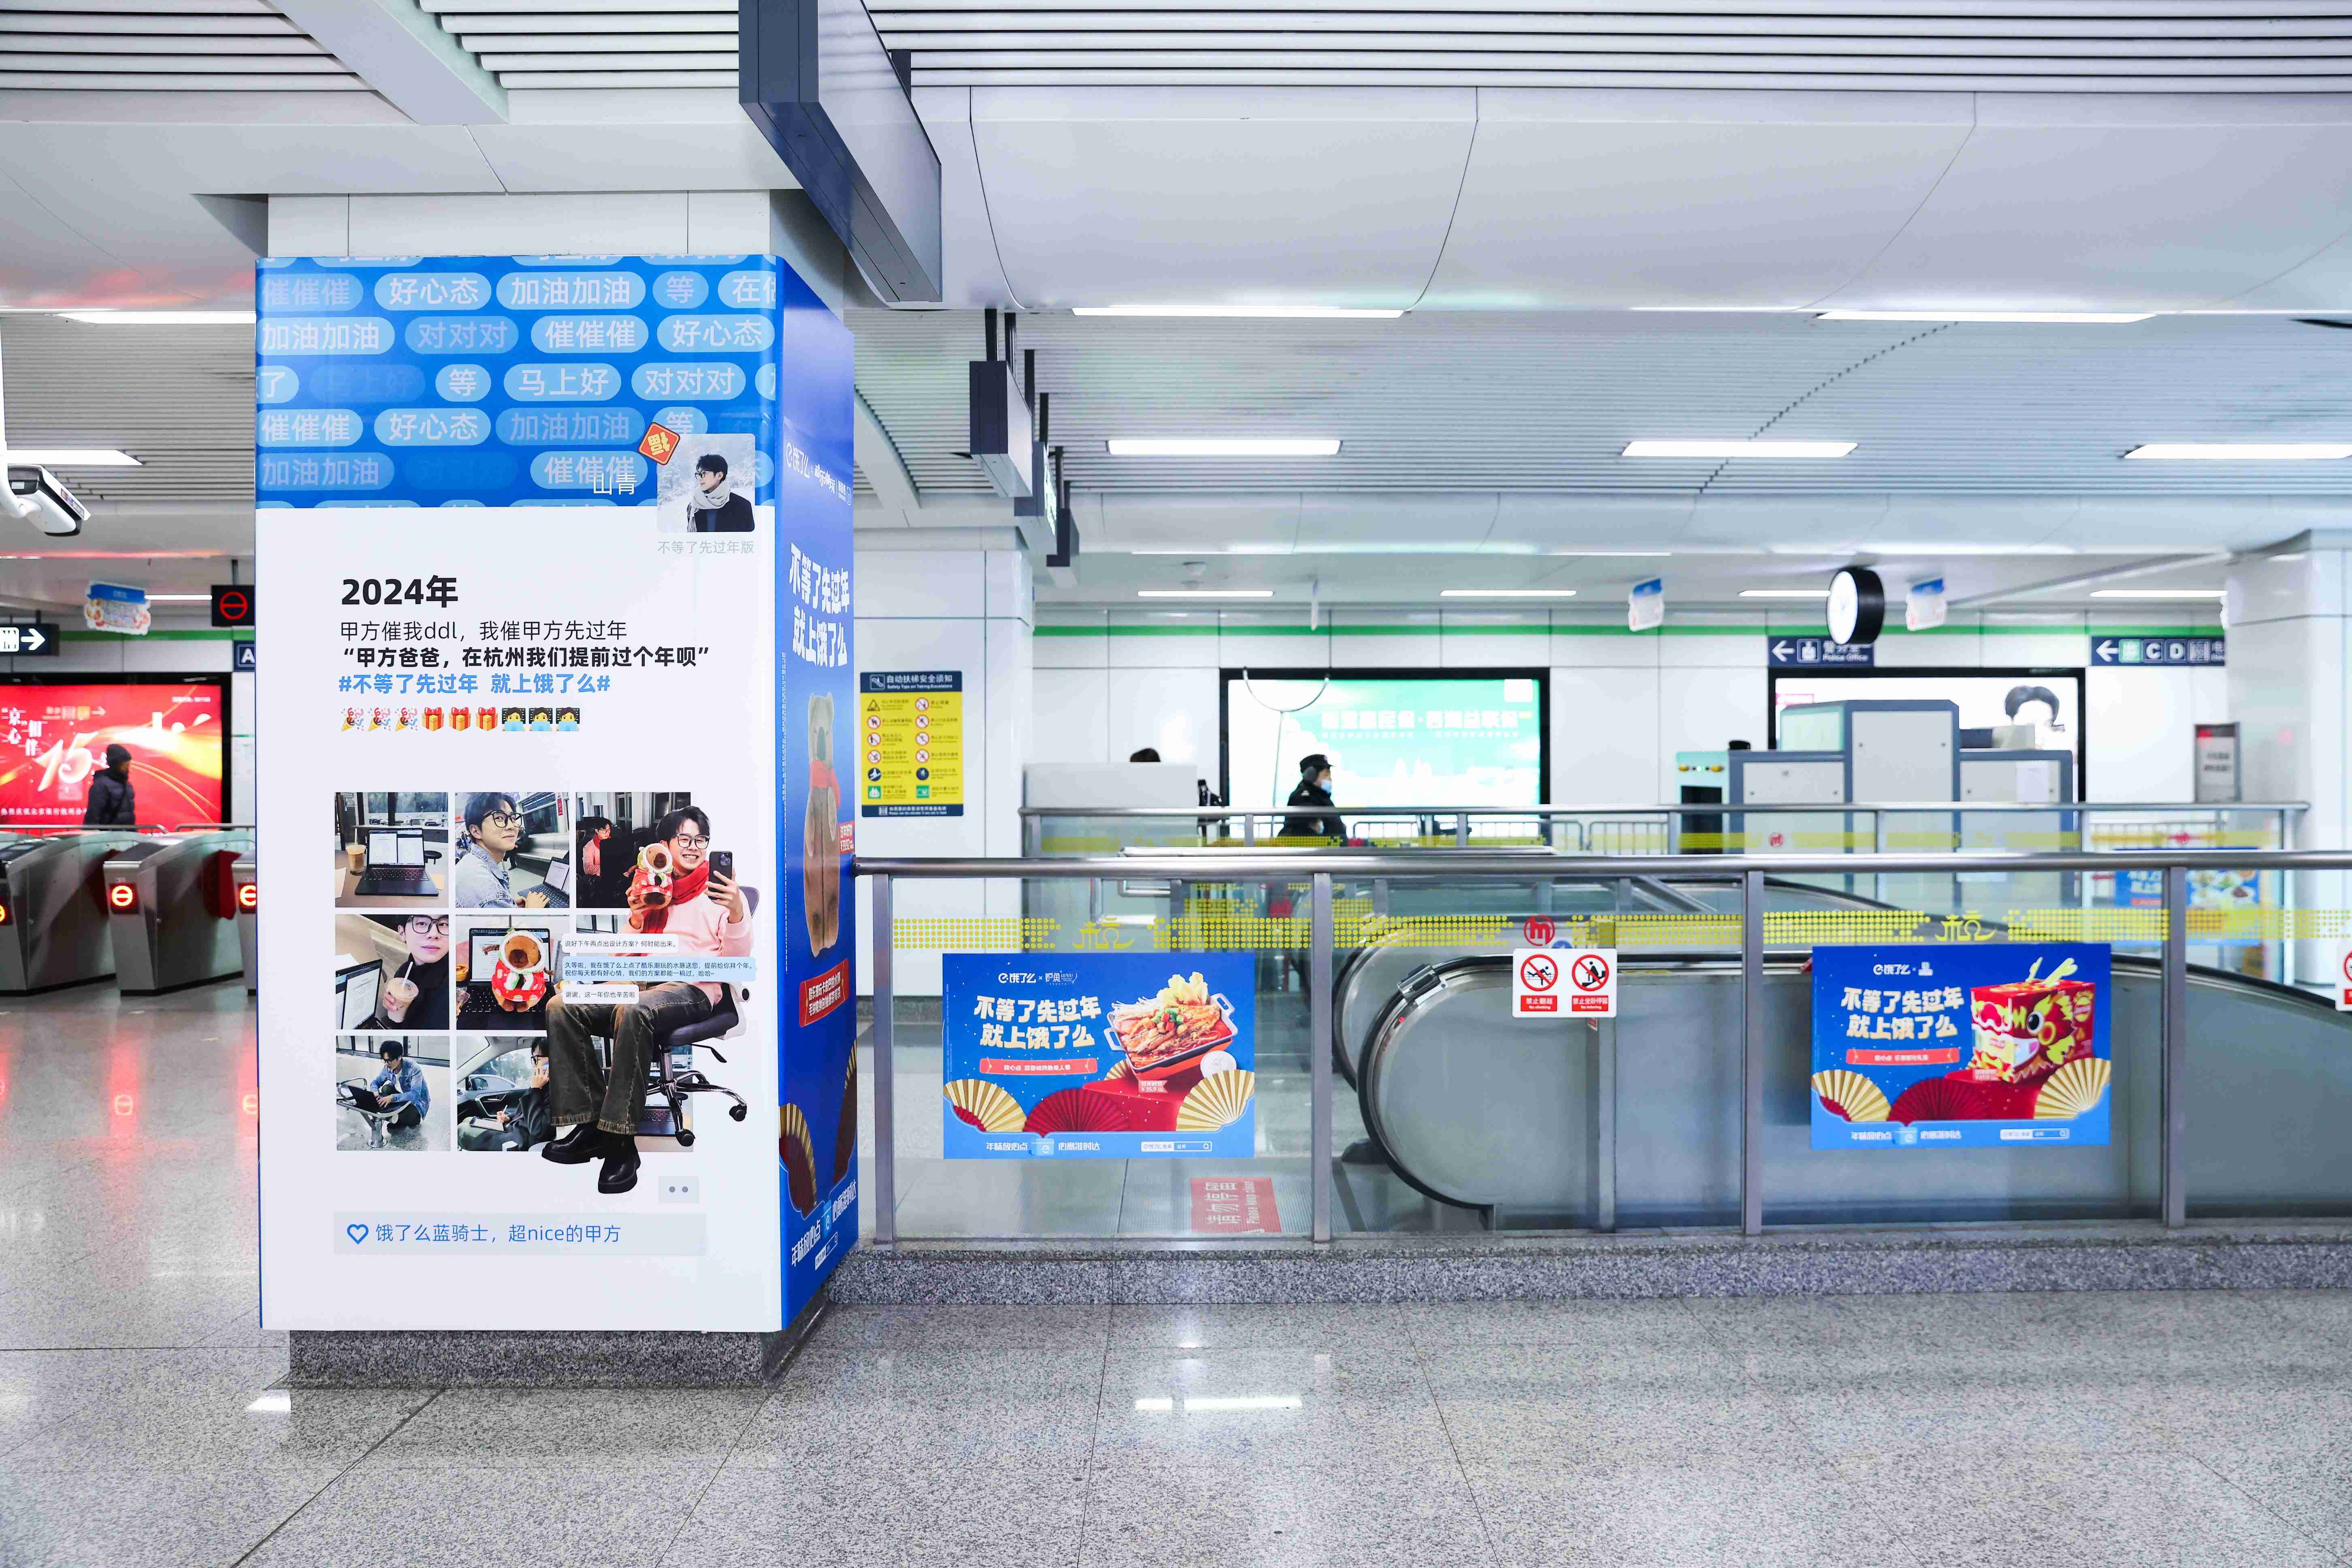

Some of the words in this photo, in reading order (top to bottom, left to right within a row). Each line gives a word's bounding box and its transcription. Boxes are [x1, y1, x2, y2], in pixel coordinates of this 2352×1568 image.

[263, 279, 351, 305] 催催催
[389, 278, 479, 305] 好心态
[511, 277, 630, 305] 加油加油
[666, 276, 694, 304] 等
[262, 322, 379, 349] 加油加油
[418, 322, 507, 349] 对对对
[545, 321, 636, 348] 催催催
[673, 320, 762, 347] 好心态
[449, 369, 476, 396] 等
[518, 369, 608, 396] 马上好
[645, 367, 735, 395] 对对对
[263, 415, 351, 442] 催催催
[389, 414, 479, 441] 好心态
[510, 412, 629, 440] 加油加油
[262, 458, 379, 486] 加油加油
[544, 457, 636, 484] 催催催
[592, 473, 637, 495] 山青
[658, 541, 754, 554] 不等了先过年版
[789, 541, 850, 614] 不等了先过年
[341, 575, 458, 608] 2024年
[341, 620, 627, 642] 甲方催我ddl，我催甲方先过年
[793, 604, 848, 667] 就上饿了么
[241, 648, 255, 663] A
[2146, 643, 2161, 659] C
[2169, 643, 2184, 659] D
[339, 674, 478, 695] #不等了先过年
[491, 674, 610, 694] 就上饿了么#
[887, 674, 952, 683] 自动扶梯安全须知
[1009, 973, 1036, 983] 饿了么
[974, 995, 1101, 1023] 不等了先过年
[1841, 987, 1964, 1014] 不等了先过年
[980, 1023, 1095, 1050] 就上饿了么
[1847, 1014, 1958, 1040] 就上饿了么
[986, 1142, 1028, 1151] 年味放心点
[1058, 1142, 1100, 1151] 心意准时达
[376, 1224, 621, 1244] 饿了么蓝骑士，超nice的甲方
